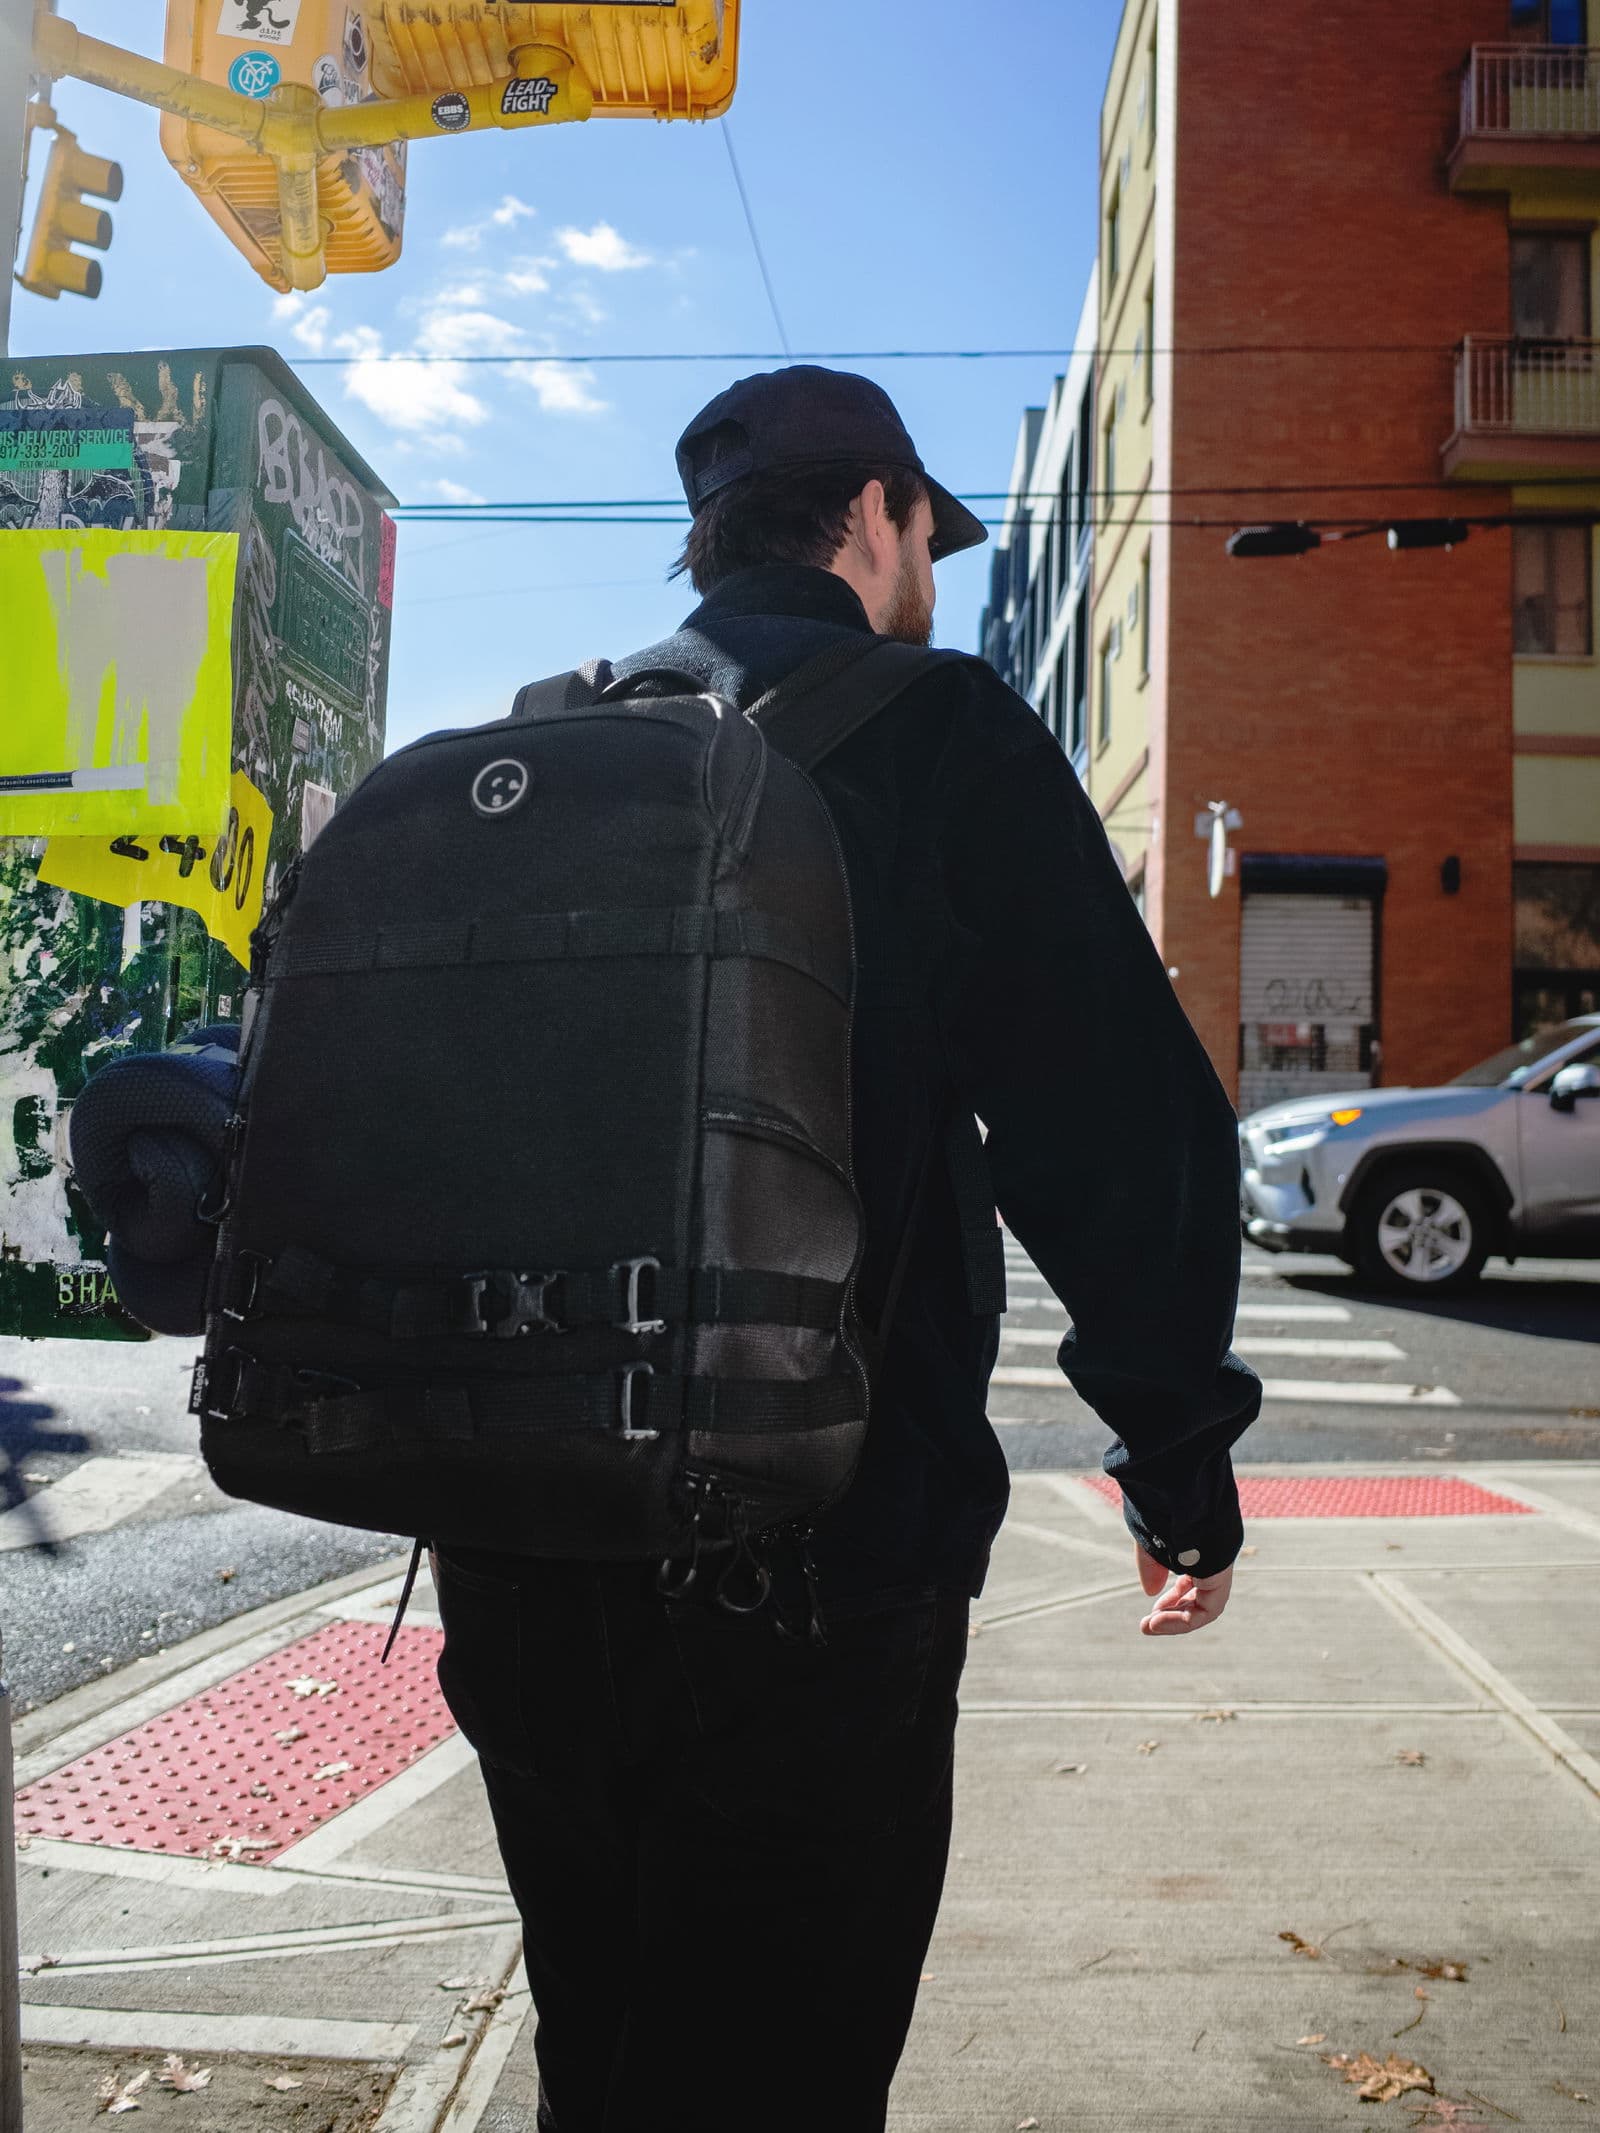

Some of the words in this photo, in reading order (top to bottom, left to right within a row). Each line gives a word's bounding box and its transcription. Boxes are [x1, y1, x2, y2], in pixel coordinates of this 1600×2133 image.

[505, 79, 548, 97] LEAD
[502, 93, 551, 113] FIGHT
[18, 430, 76, 446] DELIVERY
[78, 428, 130, 444] SERVICE
